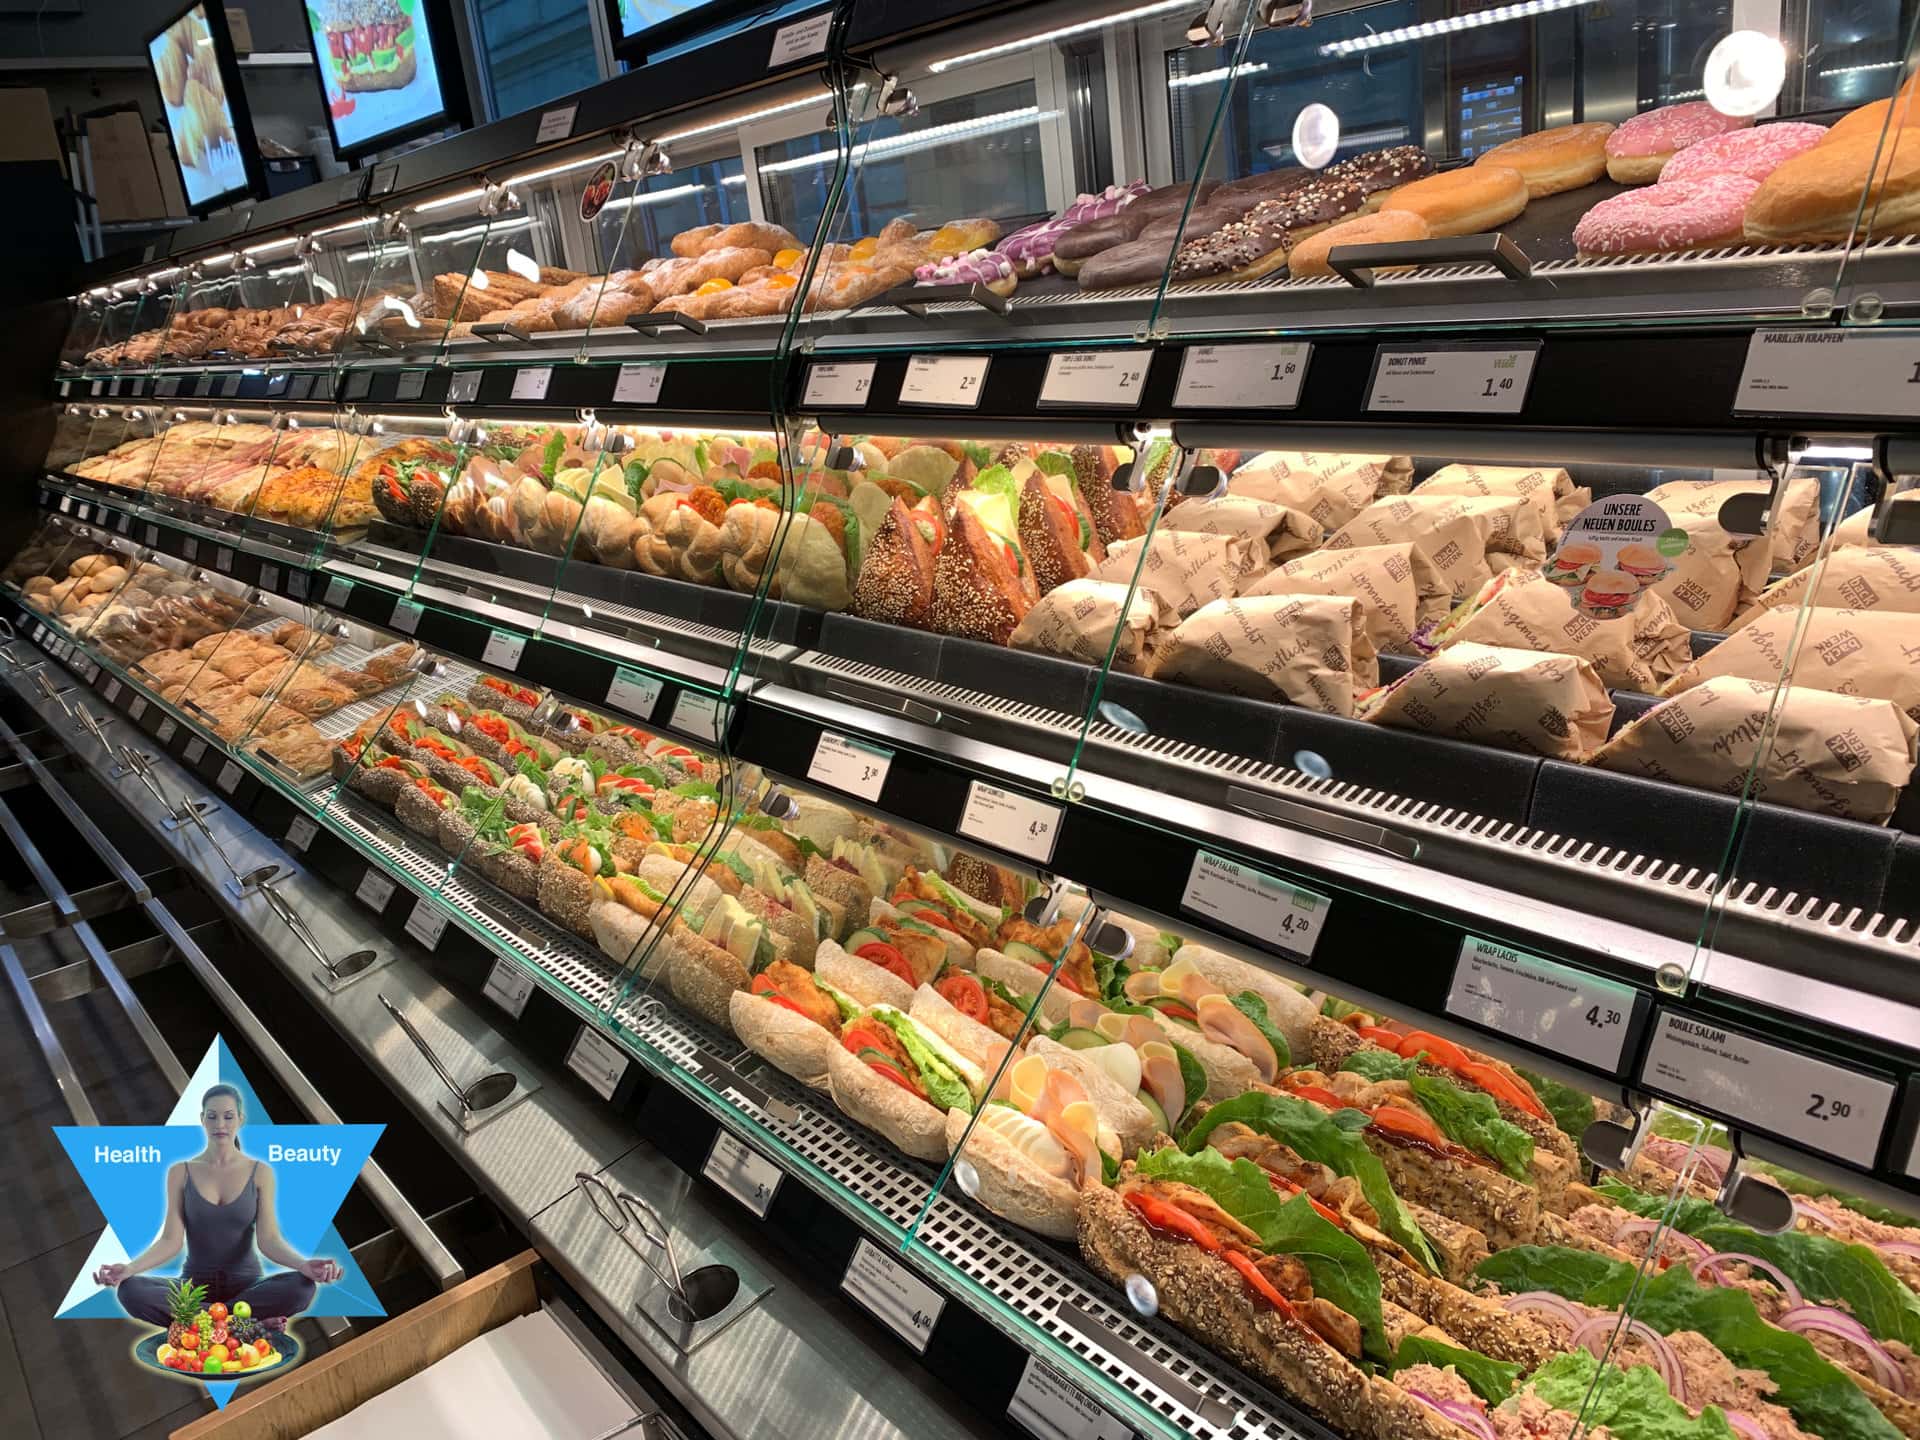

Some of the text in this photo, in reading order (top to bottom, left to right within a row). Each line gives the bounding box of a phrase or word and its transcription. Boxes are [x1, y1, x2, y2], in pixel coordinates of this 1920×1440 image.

[1764, 333, 1845, 343] MARILLEN KRAPFEN
[1271, 362, 1296, 380] 1.60
[1482, 378, 1513, 397] 1.40
[1603, 504, 1643, 516] UNSERE
[1583, 518, 1657, 532] NEUEN BOULES
[1431, 540, 1460, 566] back
[1672, 584, 1704, 612] back
[1815, 630, 1854, 652] WERK
[1822, 636, 1864, 667] back
[1654, 709, 1688, 745] back
[1671, 702, 1696, 736] WERK
[1825, 733, 1862, 773] back
[1842, 727, 1873, 766] WERK
[1029, 820, 1048, 836] 4.30
[1203, 855, 1240, 876] WRAP FALAFEL
[1282, 913, 1309, 934] 4.20
[1476, 942, 1518, 963] WRAP LACHS
[1585, 1005, 1621, 1029] 4.30
[1668, 1018, 1727, 1044] BOULE SALAMI
[1806, 1094, 1851, 1121] 2.90
[912, 1310, 931, 1328] 4.00
